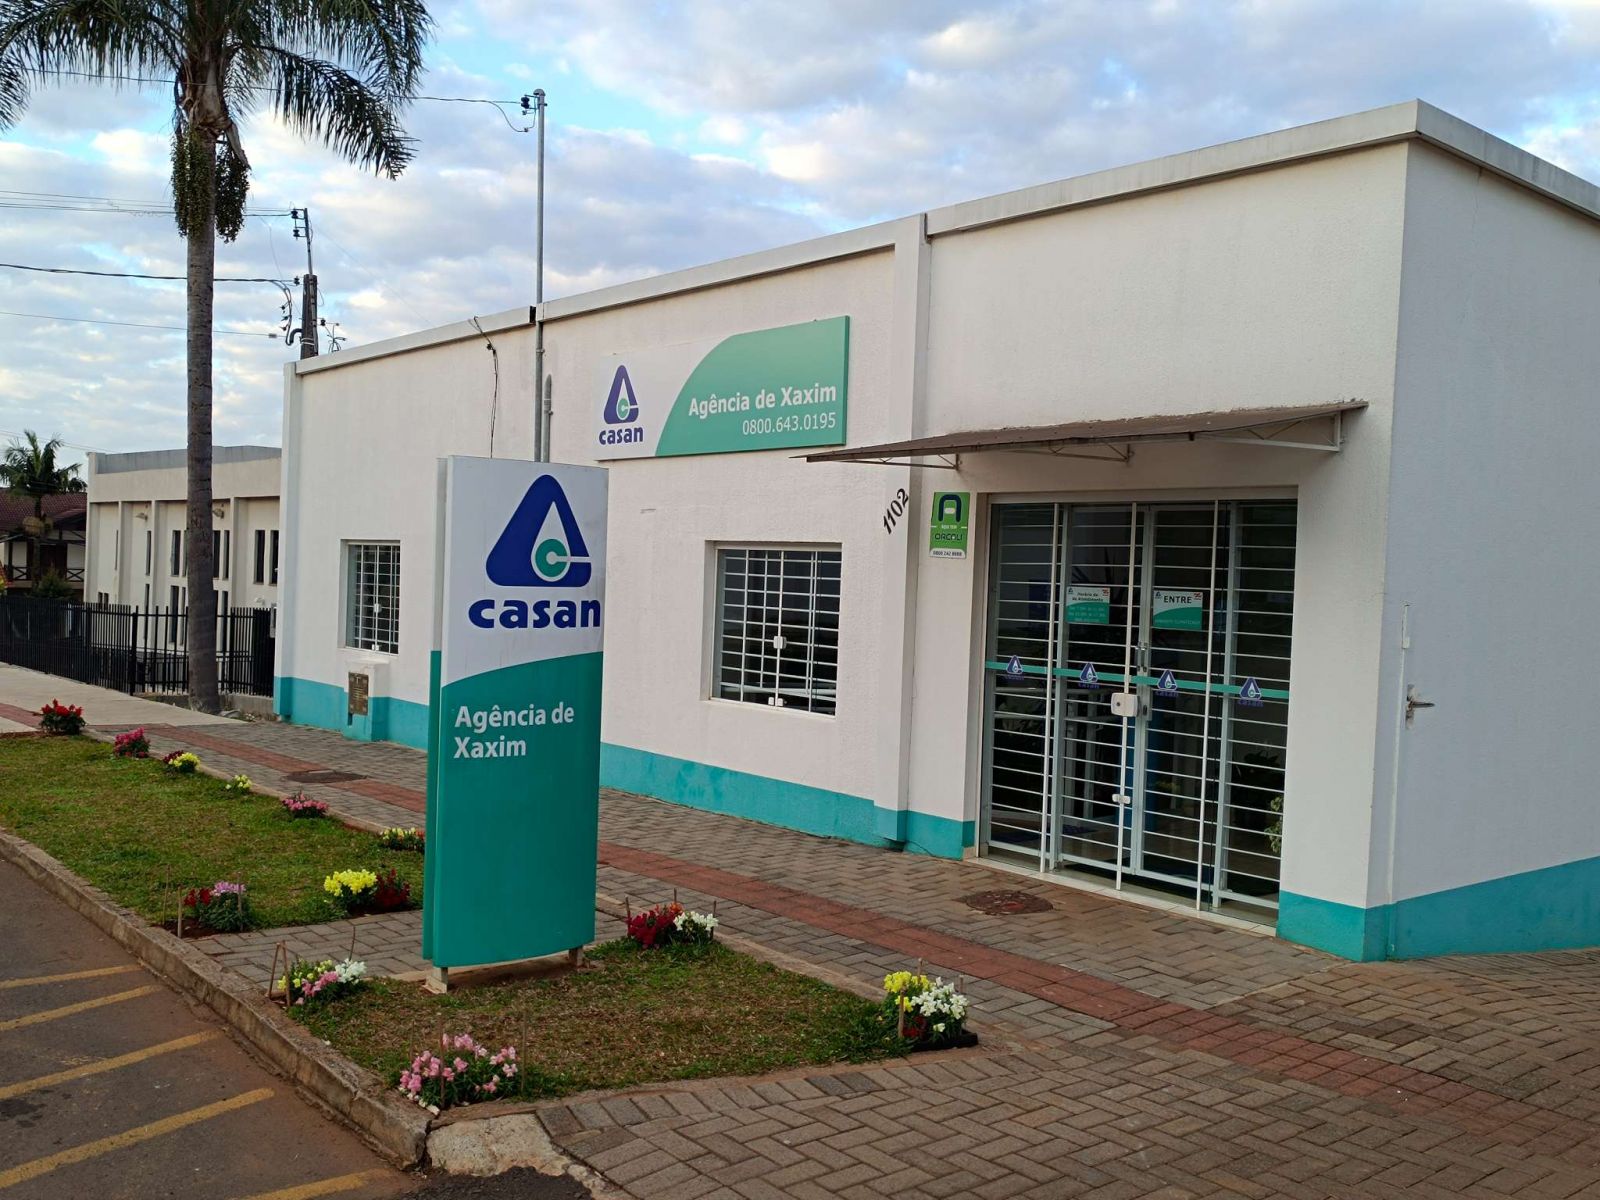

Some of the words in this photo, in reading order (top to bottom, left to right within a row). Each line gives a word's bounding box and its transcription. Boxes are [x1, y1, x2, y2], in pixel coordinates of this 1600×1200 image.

[688, 393, 750, 419] Agência
[755, 390, 776, 409] de
[780, 384, 837, 407] Xaxim
[599, 426, 643, 446] casan
[742, 412, 837, 436] 0800.643.0195
[883, 488, 909, 535] 1102
[1164, 595, 1192, 604] ENTRE
[468, 599, 601, 629] casan
[454, 704, 547, 733] Agência
[551, 702, 575, 724] de
[453, 735, 527, 759] Xaxim
